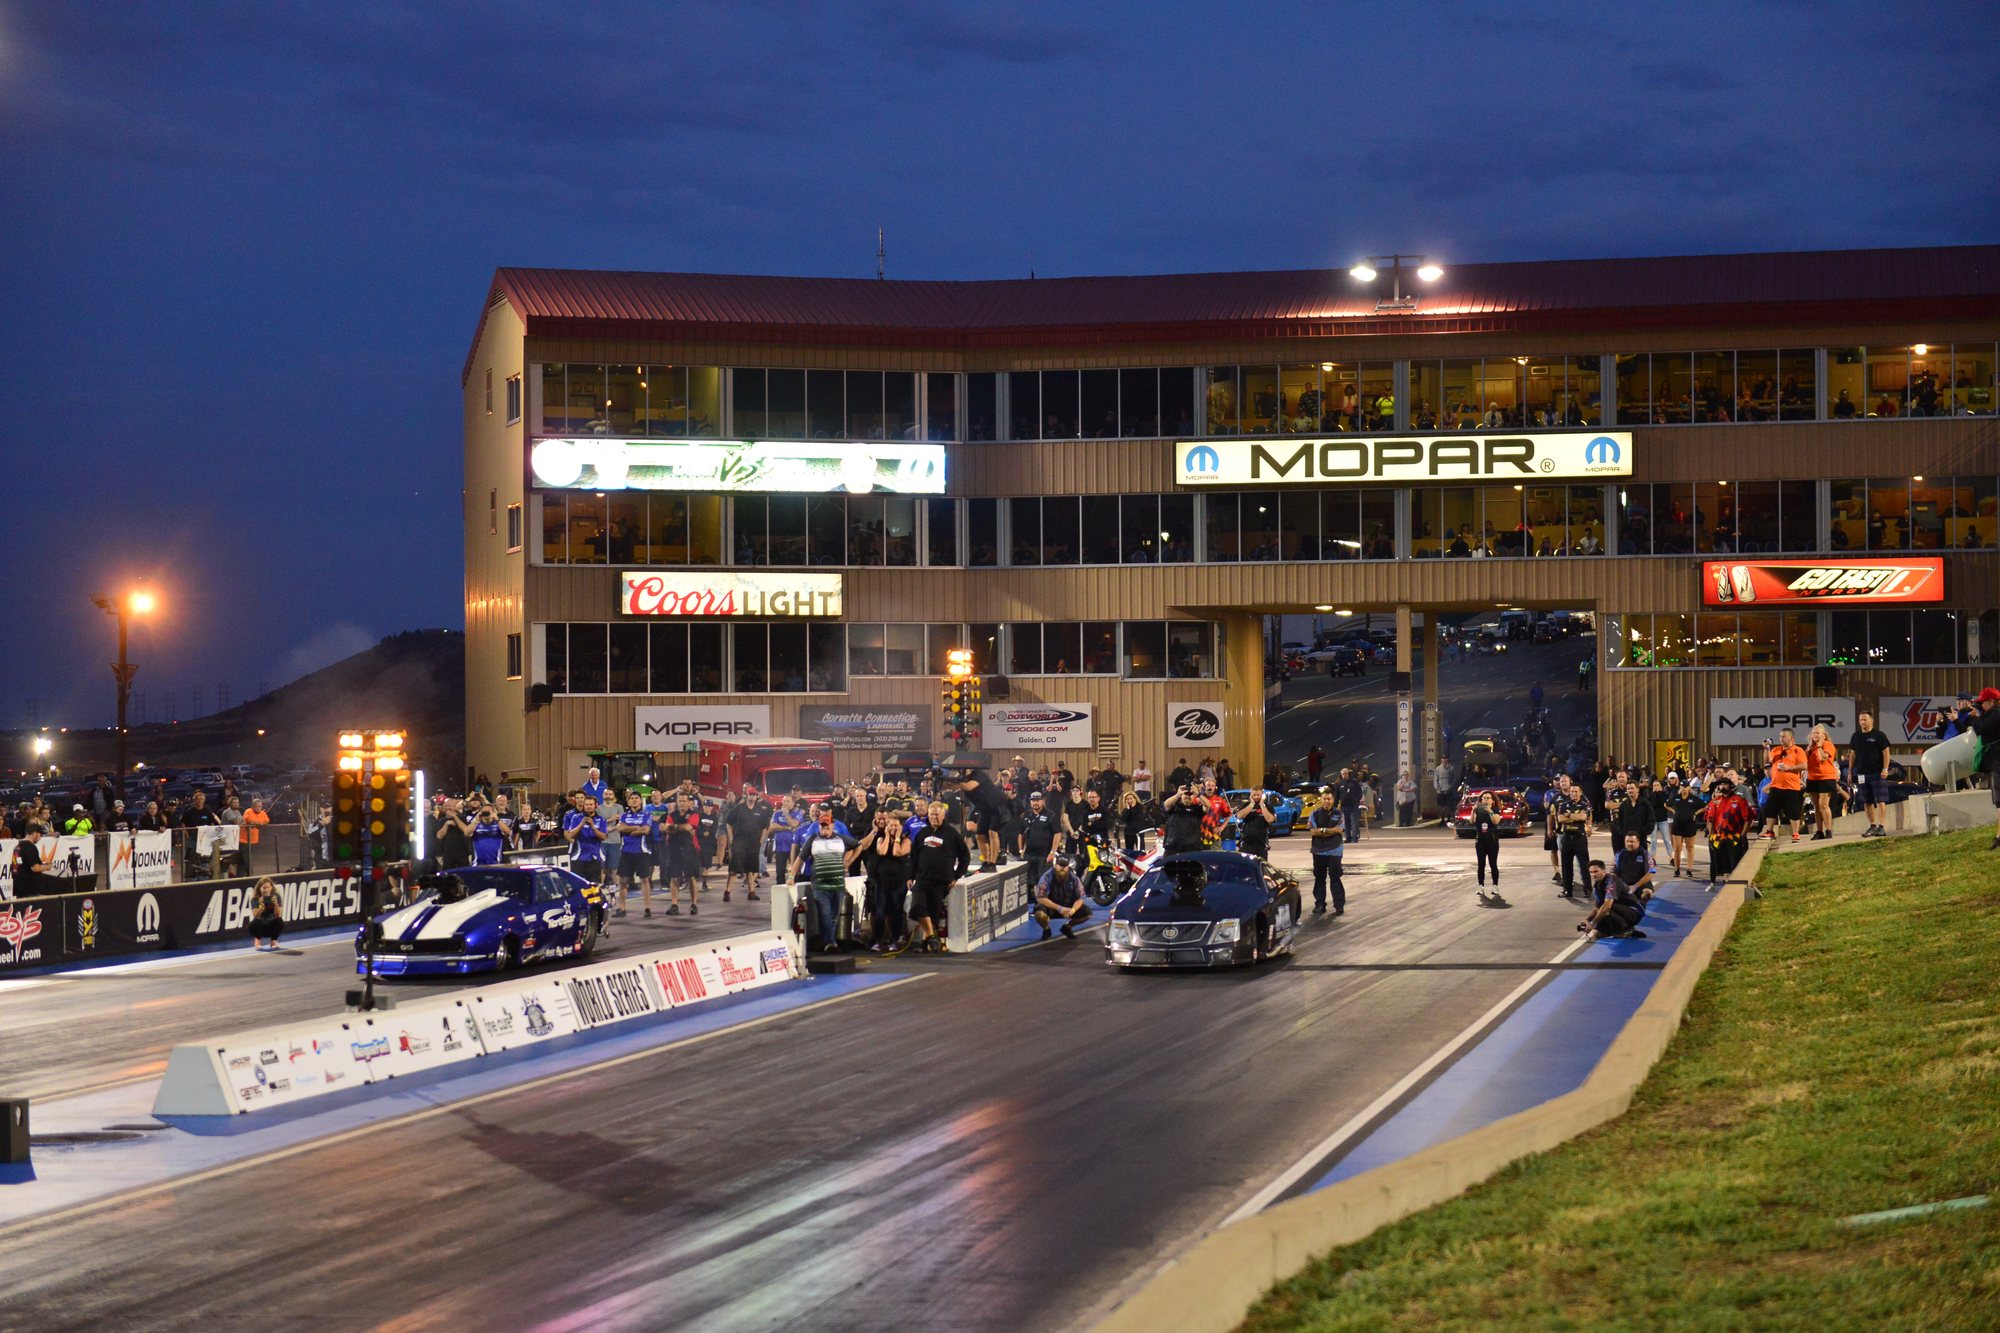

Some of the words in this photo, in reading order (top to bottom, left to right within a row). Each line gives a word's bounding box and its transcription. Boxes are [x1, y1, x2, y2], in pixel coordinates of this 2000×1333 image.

[1251, 438, 1537, 479] MOPAR
[1787, 568, 1843, 591] GO
[1828, 569, 1893, 590] FAST
[627, 576, 738, 616] Coors
[743, 590, 834, 616] LIGHT
[645, 721, 753, 736] MOPAR
[822, 712, 862, 723] Corvette
[865, 712, 918, 724] Connection
[1173, 712, 1219, 738] Gates
[1719, 714, 1837, 730] MOPAR
[1399, 717, 1409, 767] MOPAR
[1426, 717, 1435, 763] MOPAR
[54, 858, 92, 873] NOAN
[224, 877, 344, 932] BAIMERE
[136, 933, 161, 943] MOPAR
[567, 976, 614, 1025] WORLD
[606, 968, 650, 1017] SERIES
[656, 961, 685, 1005] PRO
[676, 957, 707, 1001] MOD
